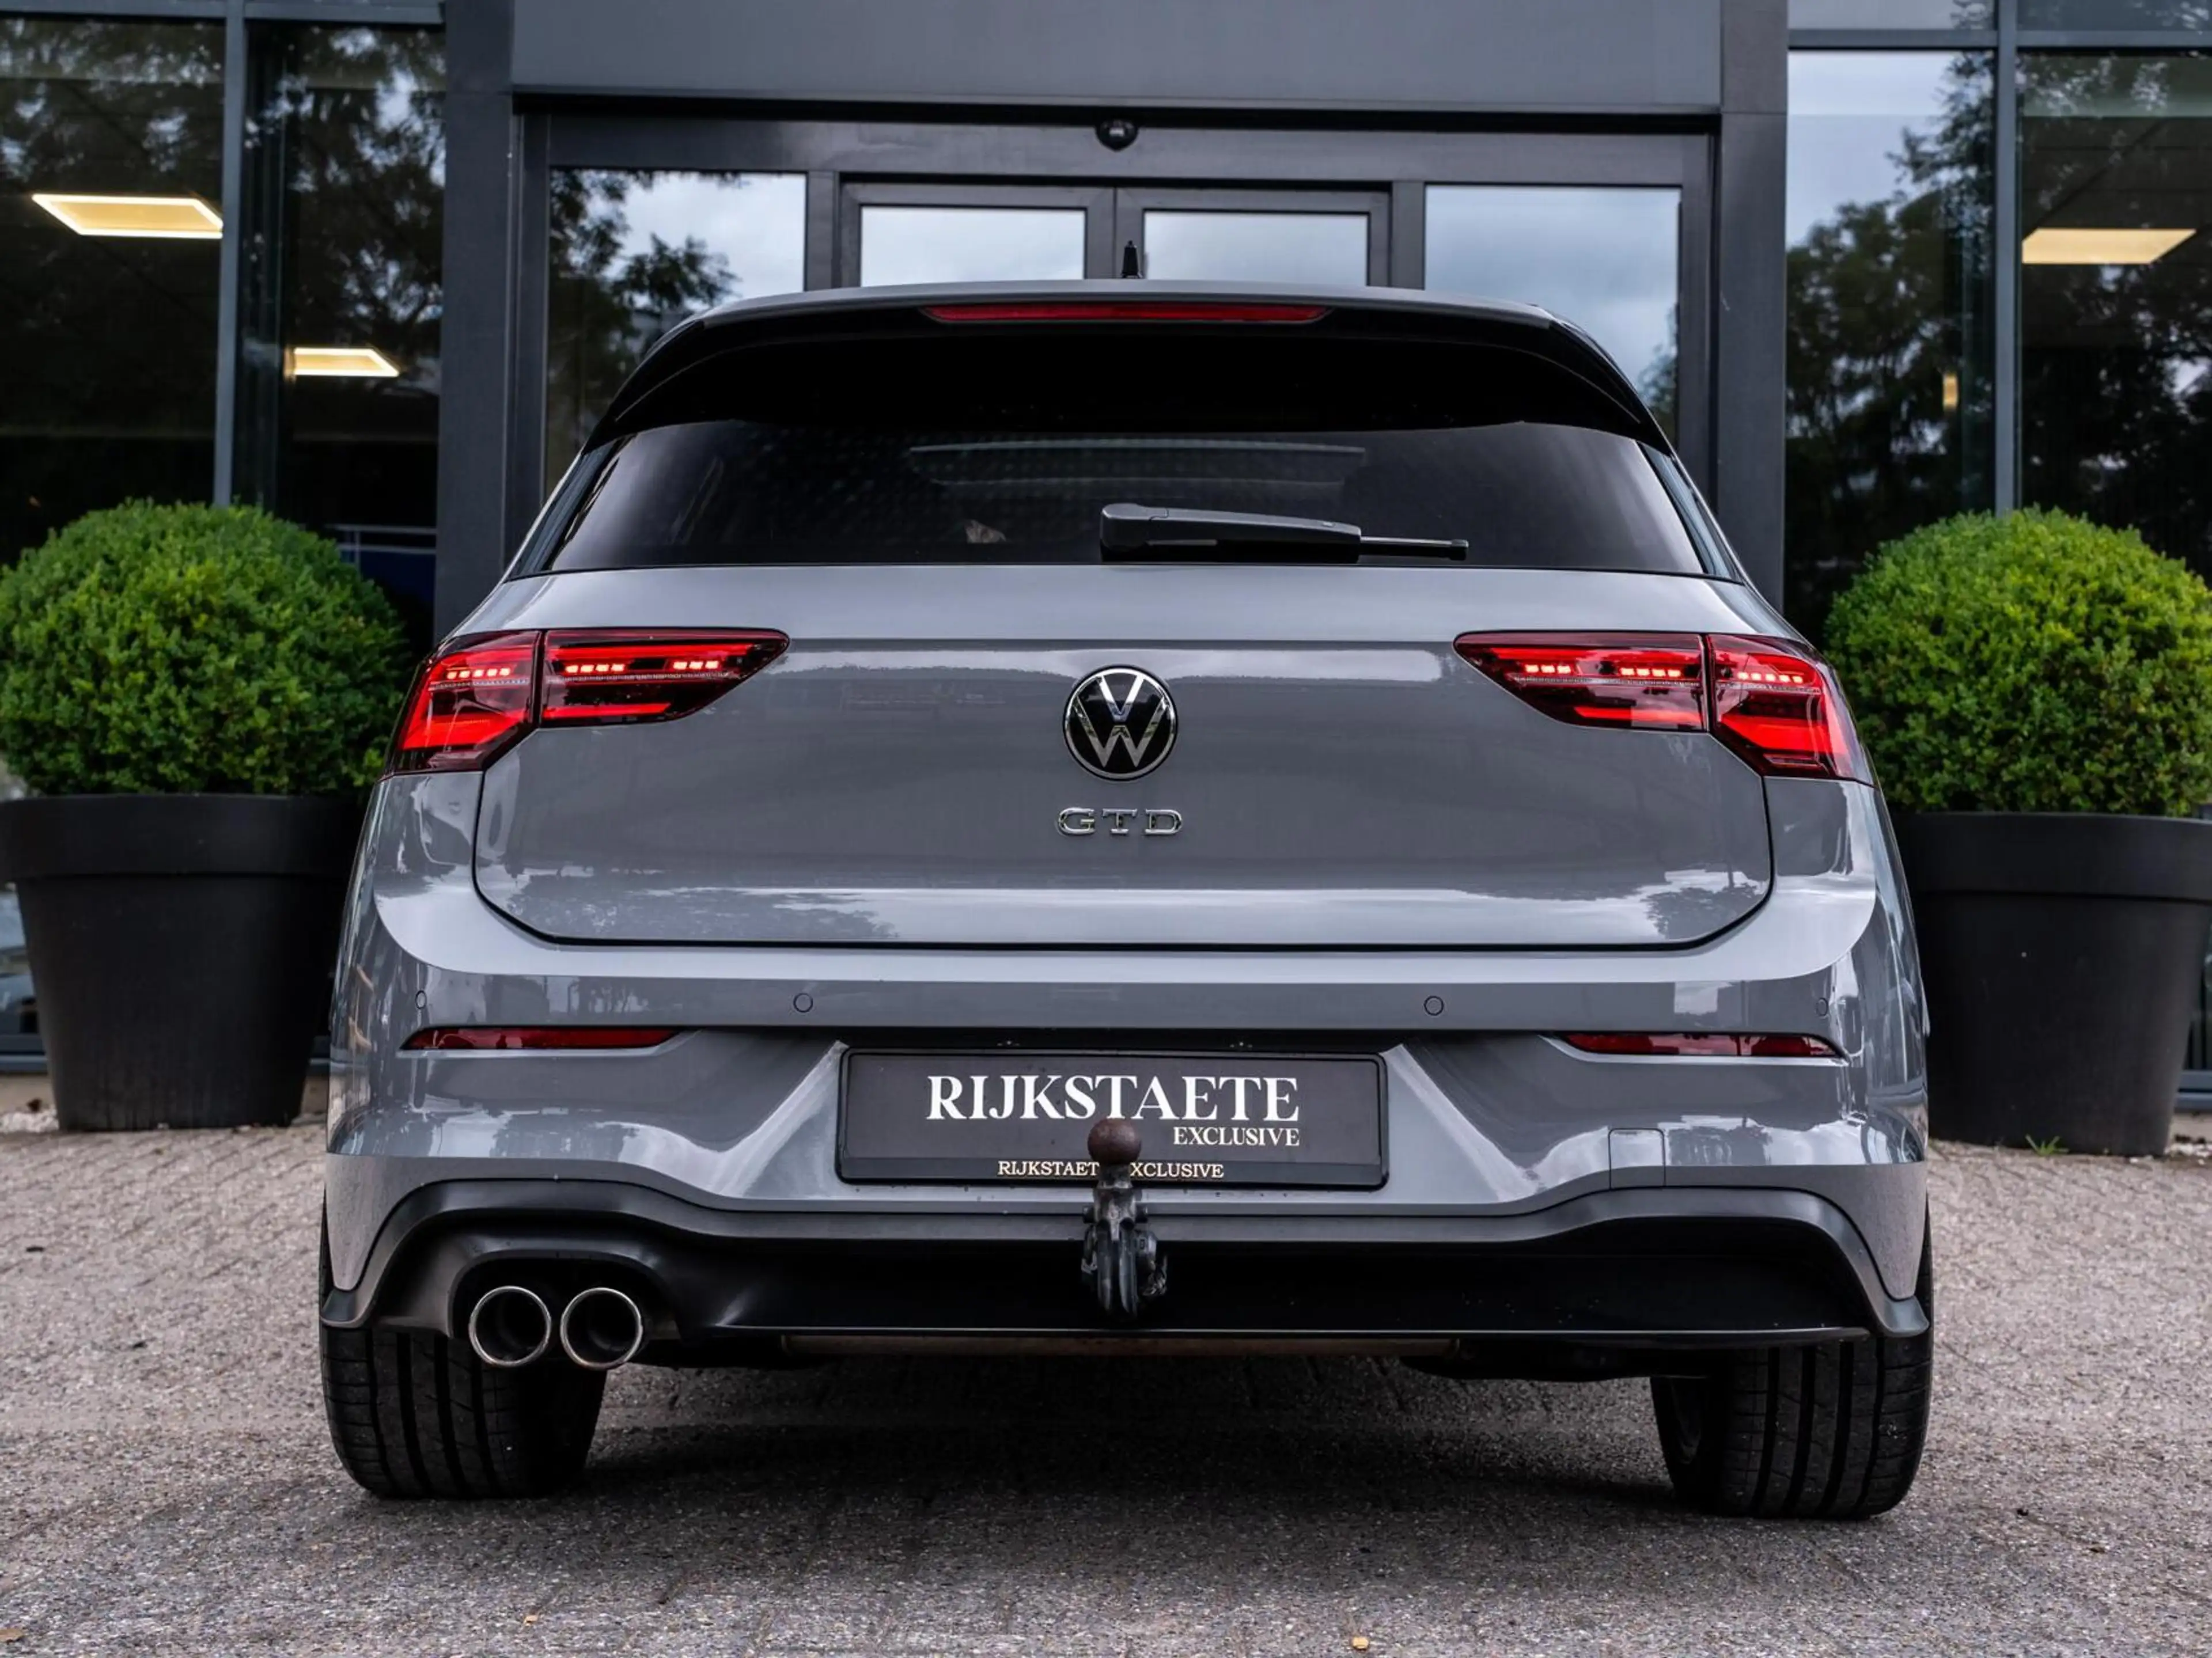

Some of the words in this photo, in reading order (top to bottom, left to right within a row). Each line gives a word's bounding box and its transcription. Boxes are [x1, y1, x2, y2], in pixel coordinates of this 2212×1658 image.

[1057, 806, 1183, 836] GTD
[926, 1075, 1299, 1122] RIJKSTAETE
[1173, 1126, 1300, 1147] EXCLUSIVE
[998, 1160, 1100, 1177] RIJKSTAET
[1129, 1162, 1225, 1179] XCLUSIVE
